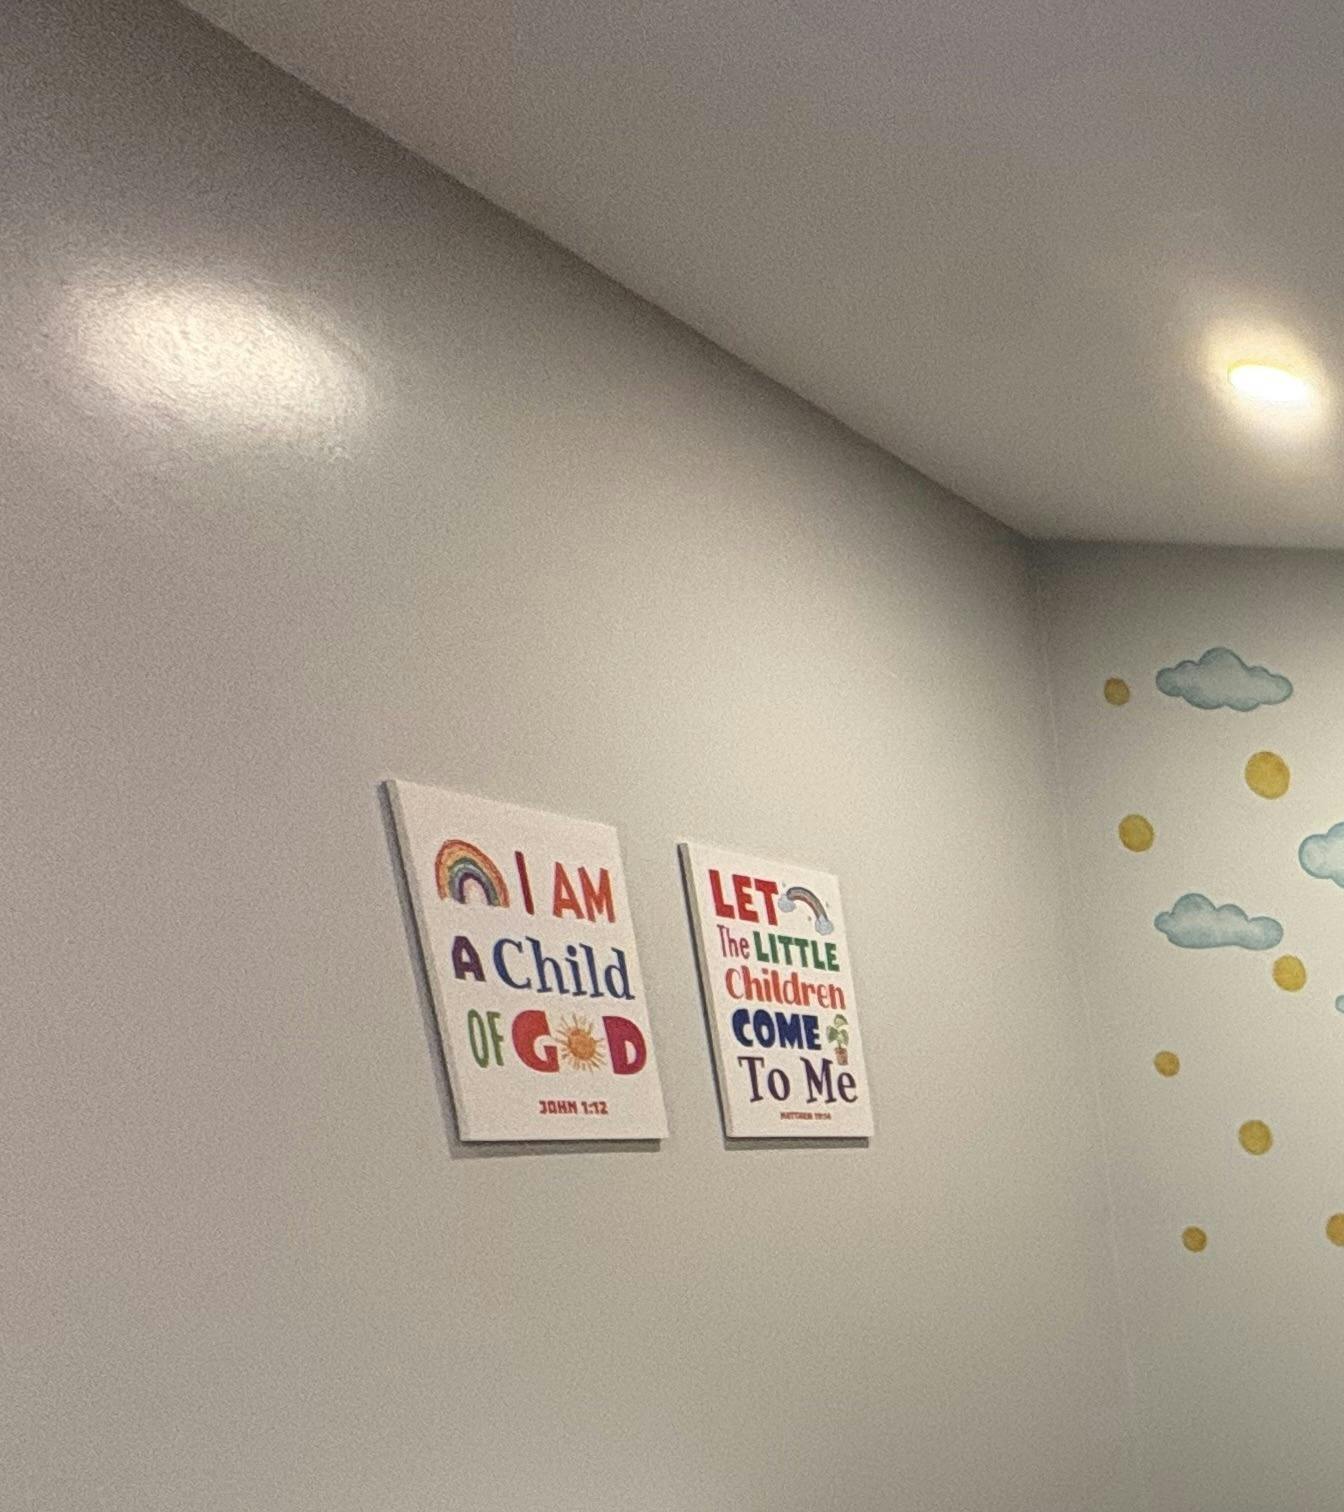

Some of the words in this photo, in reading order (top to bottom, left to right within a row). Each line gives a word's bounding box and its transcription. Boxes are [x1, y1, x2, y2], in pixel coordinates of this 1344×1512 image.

[514, 850, 535, 915] I
[552, 861, 616, 923] AM
[708, 869, 780, 926] LET
[452, 935, 487, 983] A
[493, 937, 636, 1001] Child
[716, 925, 751, 960] The
[752, 930, 841, 972] LITTLE
[725, 967, 847, 1010] Children
[467, 1008, 505, 1068] OF
[731, 1008, 822, 1051] COME
[738, 1056, 791, 1103] To
[800, 1058, 859, 1104] Me
[539, 1100, 578, 1115] JOHN
[582, 1101, 609, 1115] 1:12
